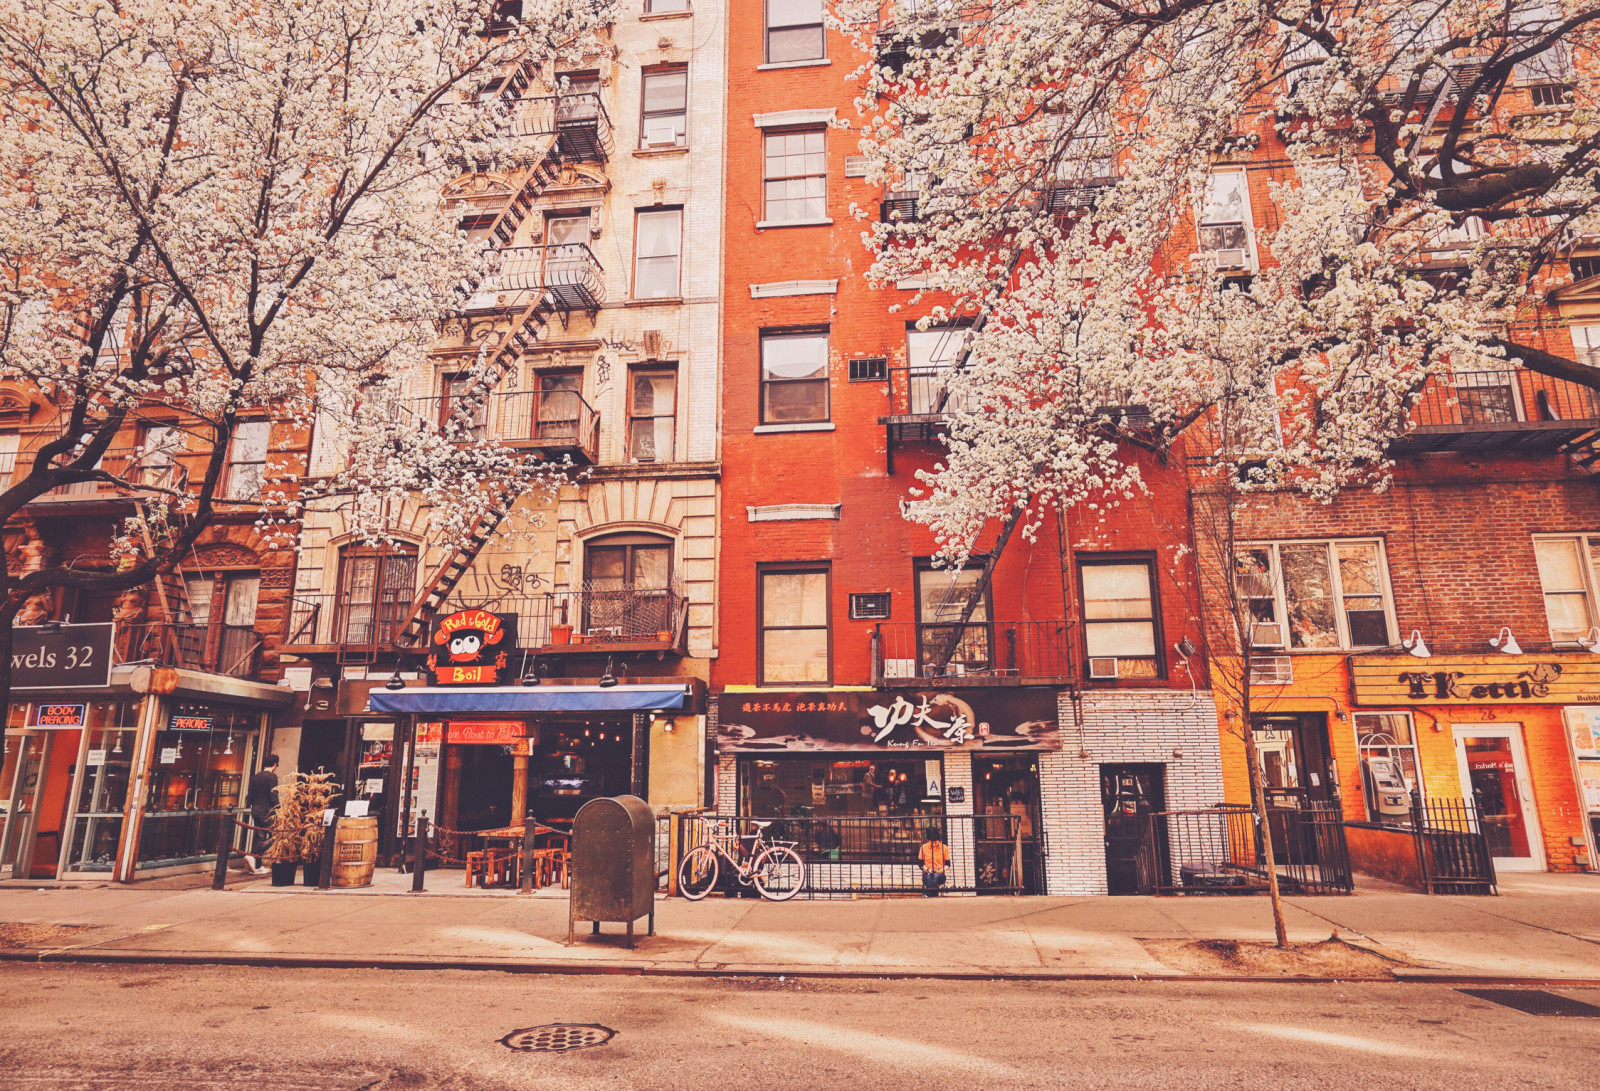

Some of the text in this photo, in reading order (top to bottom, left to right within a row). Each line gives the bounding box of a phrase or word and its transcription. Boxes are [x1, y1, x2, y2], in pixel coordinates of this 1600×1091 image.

[444, 612, 466, 631] Red
[475, 612, 496, 631] Gold
[64, 645, 93, 670] 32
[452, 666, 482, 682] Boil
[47, 706, 76, 716] BODY
[1481, 709, 1496, 721] 26
[40, 715, 80, 725] PIERCING
[175, 717, 208, 729] PIERCING
[867, 694, 975, 744] 功夫茶
[462, 726, 485, 739] Boat
[485, 729, 496, 739] to
[887, 739, 910, 749] Kung
[912, 739, 924, 747] Fu
[929, 780, 939, 791] A
